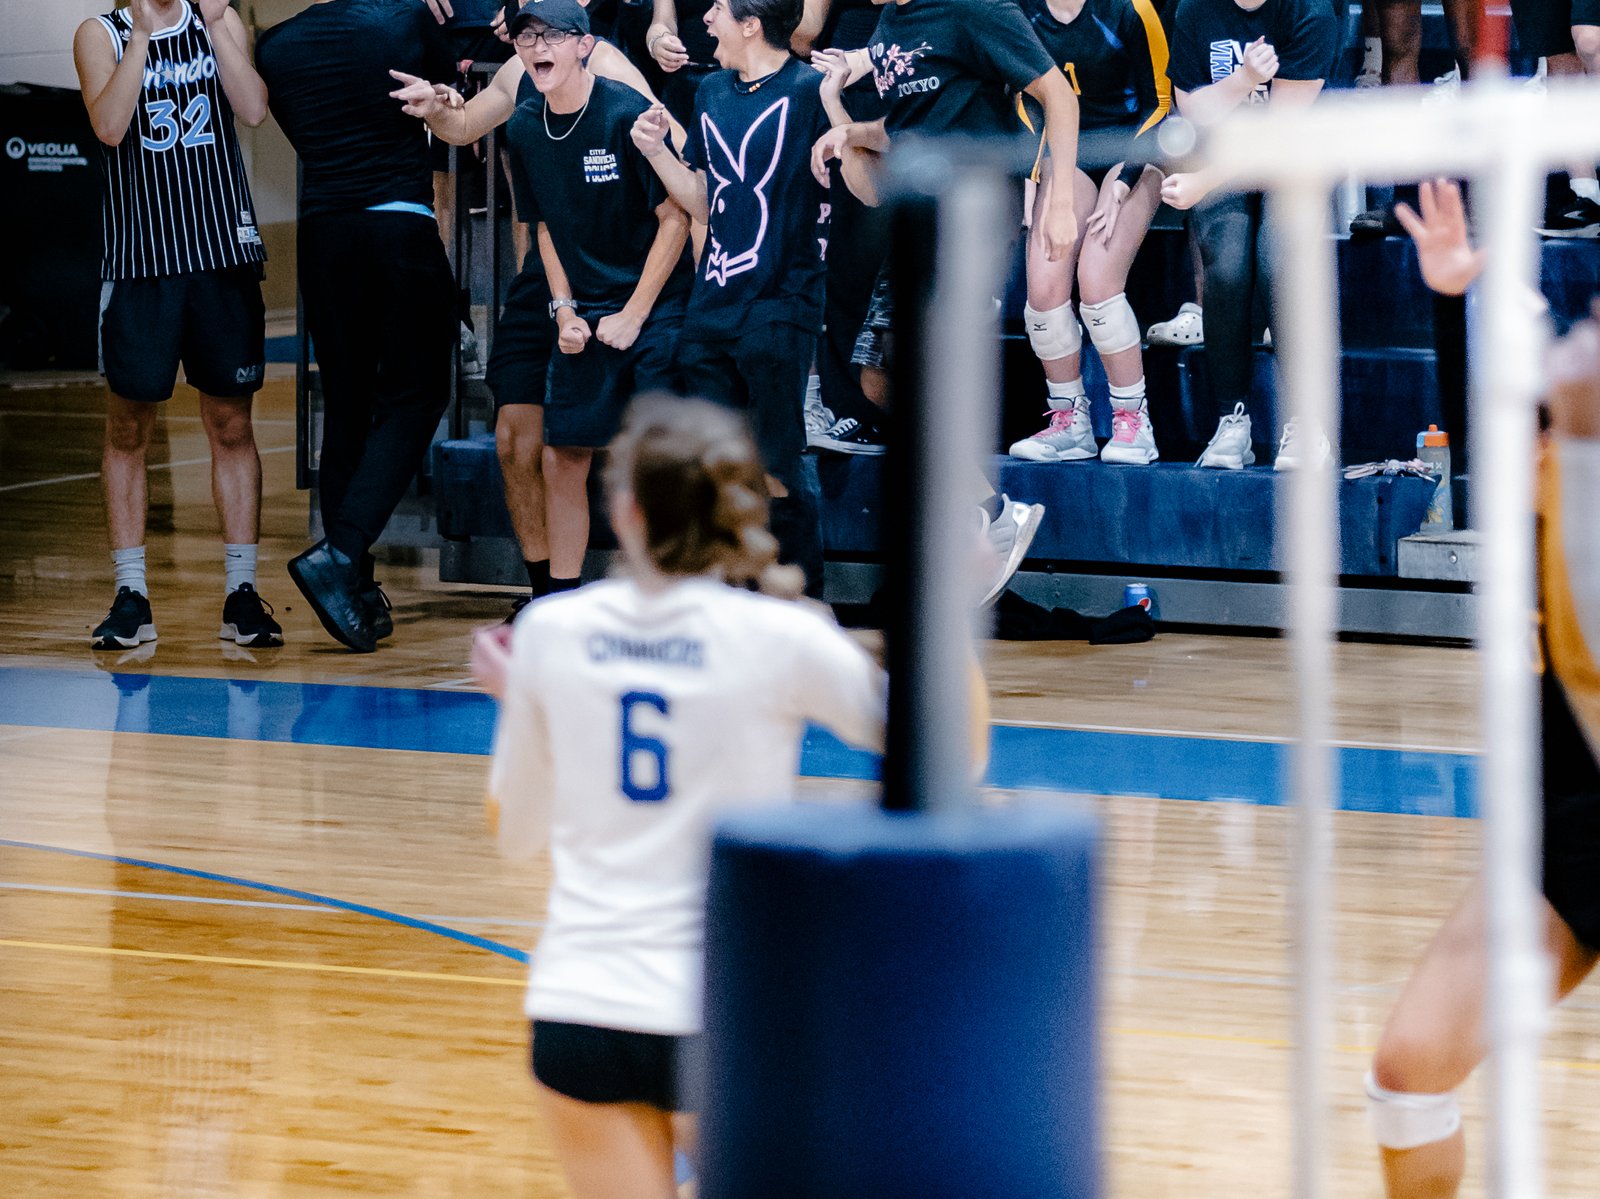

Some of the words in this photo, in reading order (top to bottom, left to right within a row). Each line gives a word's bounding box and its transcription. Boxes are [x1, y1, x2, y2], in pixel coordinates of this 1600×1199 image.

[897, 76, 940, 98] TOKYO
[141, 93, 216, 152] 32
[27, 143, 79, 156] VEOLIA
[621, 690, 670, 802] 6
